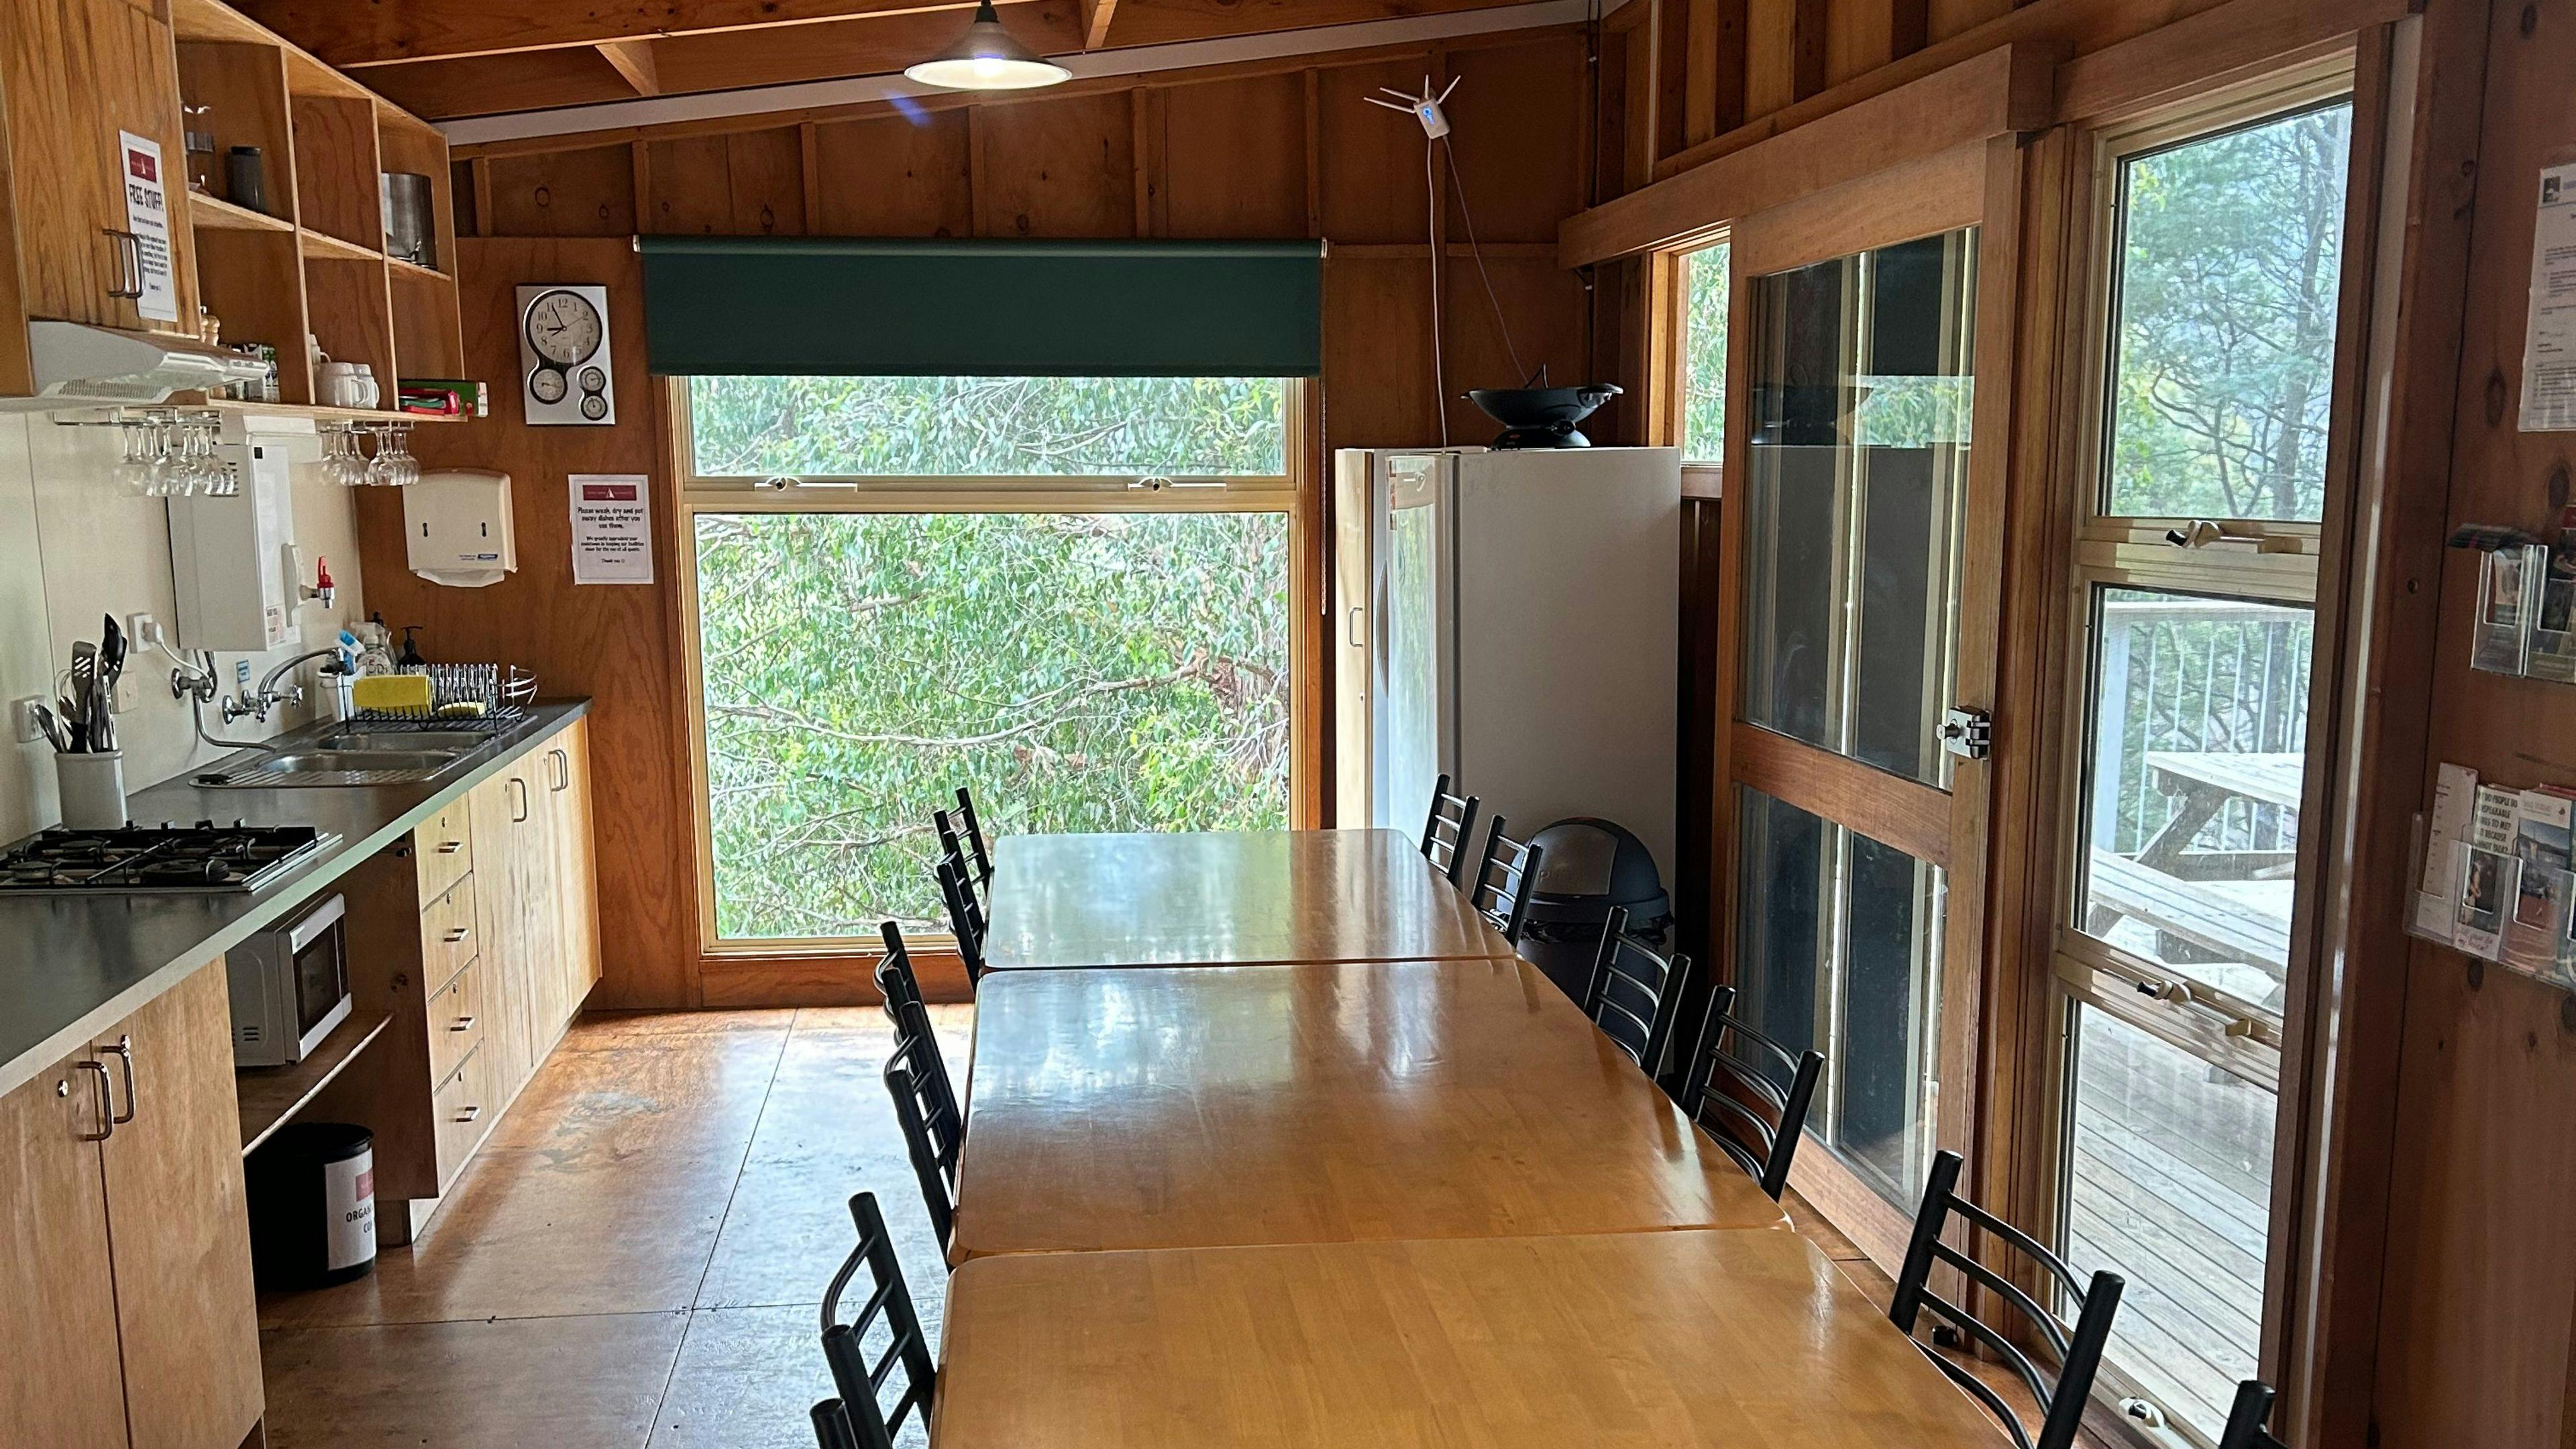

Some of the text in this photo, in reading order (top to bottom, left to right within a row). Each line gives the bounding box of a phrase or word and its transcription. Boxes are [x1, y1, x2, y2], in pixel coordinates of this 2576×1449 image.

[129, 184, 164, 213] FREE STUFF!
[557, 299, 568, 308] 12
[574, 302, 578, 312] 1
[537, 311, 547, 321] 10
[582, 311, 588, 321] 2
[537, 323, 543, 333] 9
[586, 323, 593, 333] 3
[541, 337, 547, 345] 8
[585, 337, 590, 346] 4
[551, 345, 557, 356] 7
[564, 348, 570, 358] 6
[576, 345, 582, 355] 5
[346, 1205, 372, 1222] ORGAN
